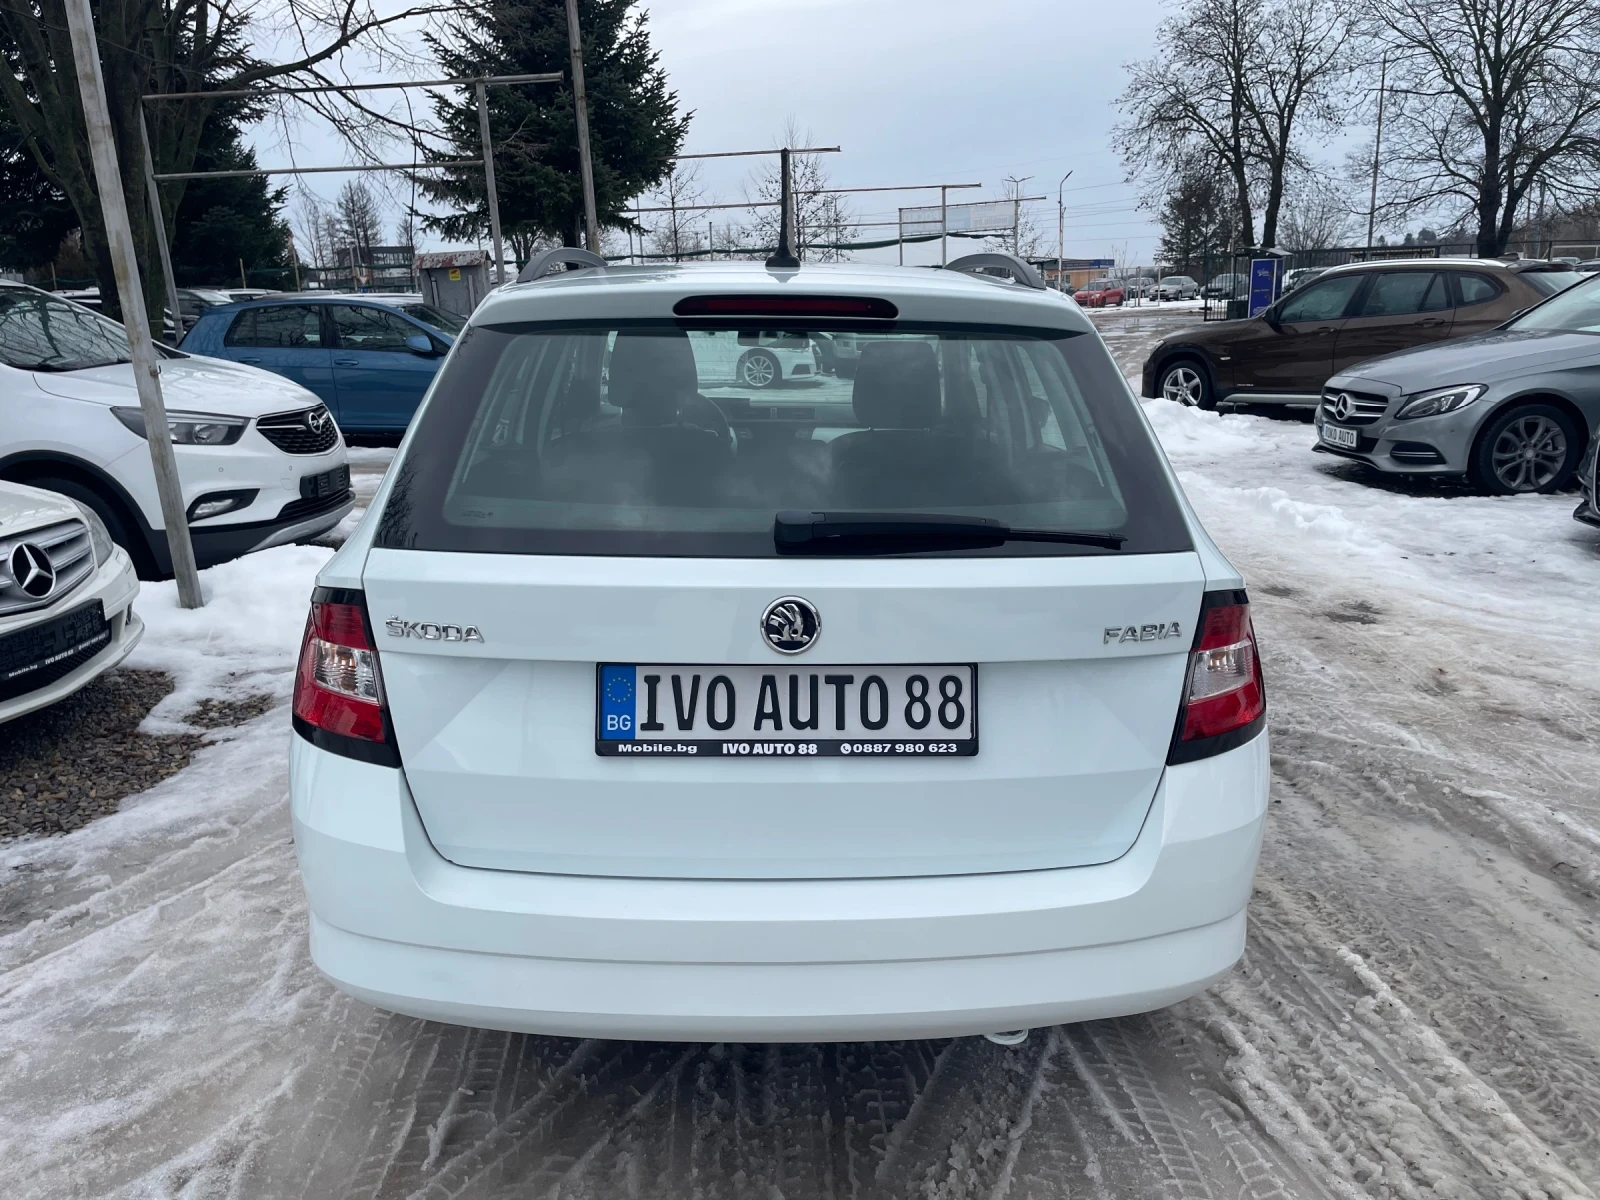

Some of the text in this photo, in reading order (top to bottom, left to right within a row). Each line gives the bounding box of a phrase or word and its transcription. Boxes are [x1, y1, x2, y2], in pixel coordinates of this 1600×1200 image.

[1338, 430, 1354, 444] AUTO
[385, 614, 485, 643] ŠKODA
[1103, 621, 1182, 645] FABIA
[640, 674, 965, 731] IVO AUTO 88
[607, 714, 631, 731] BG
[618, 743, 698, 754] Mobile.bg
[722, 743, 818, 754] IVO AUTO 88
[853, 743, 958, 753] 0887 980 623
